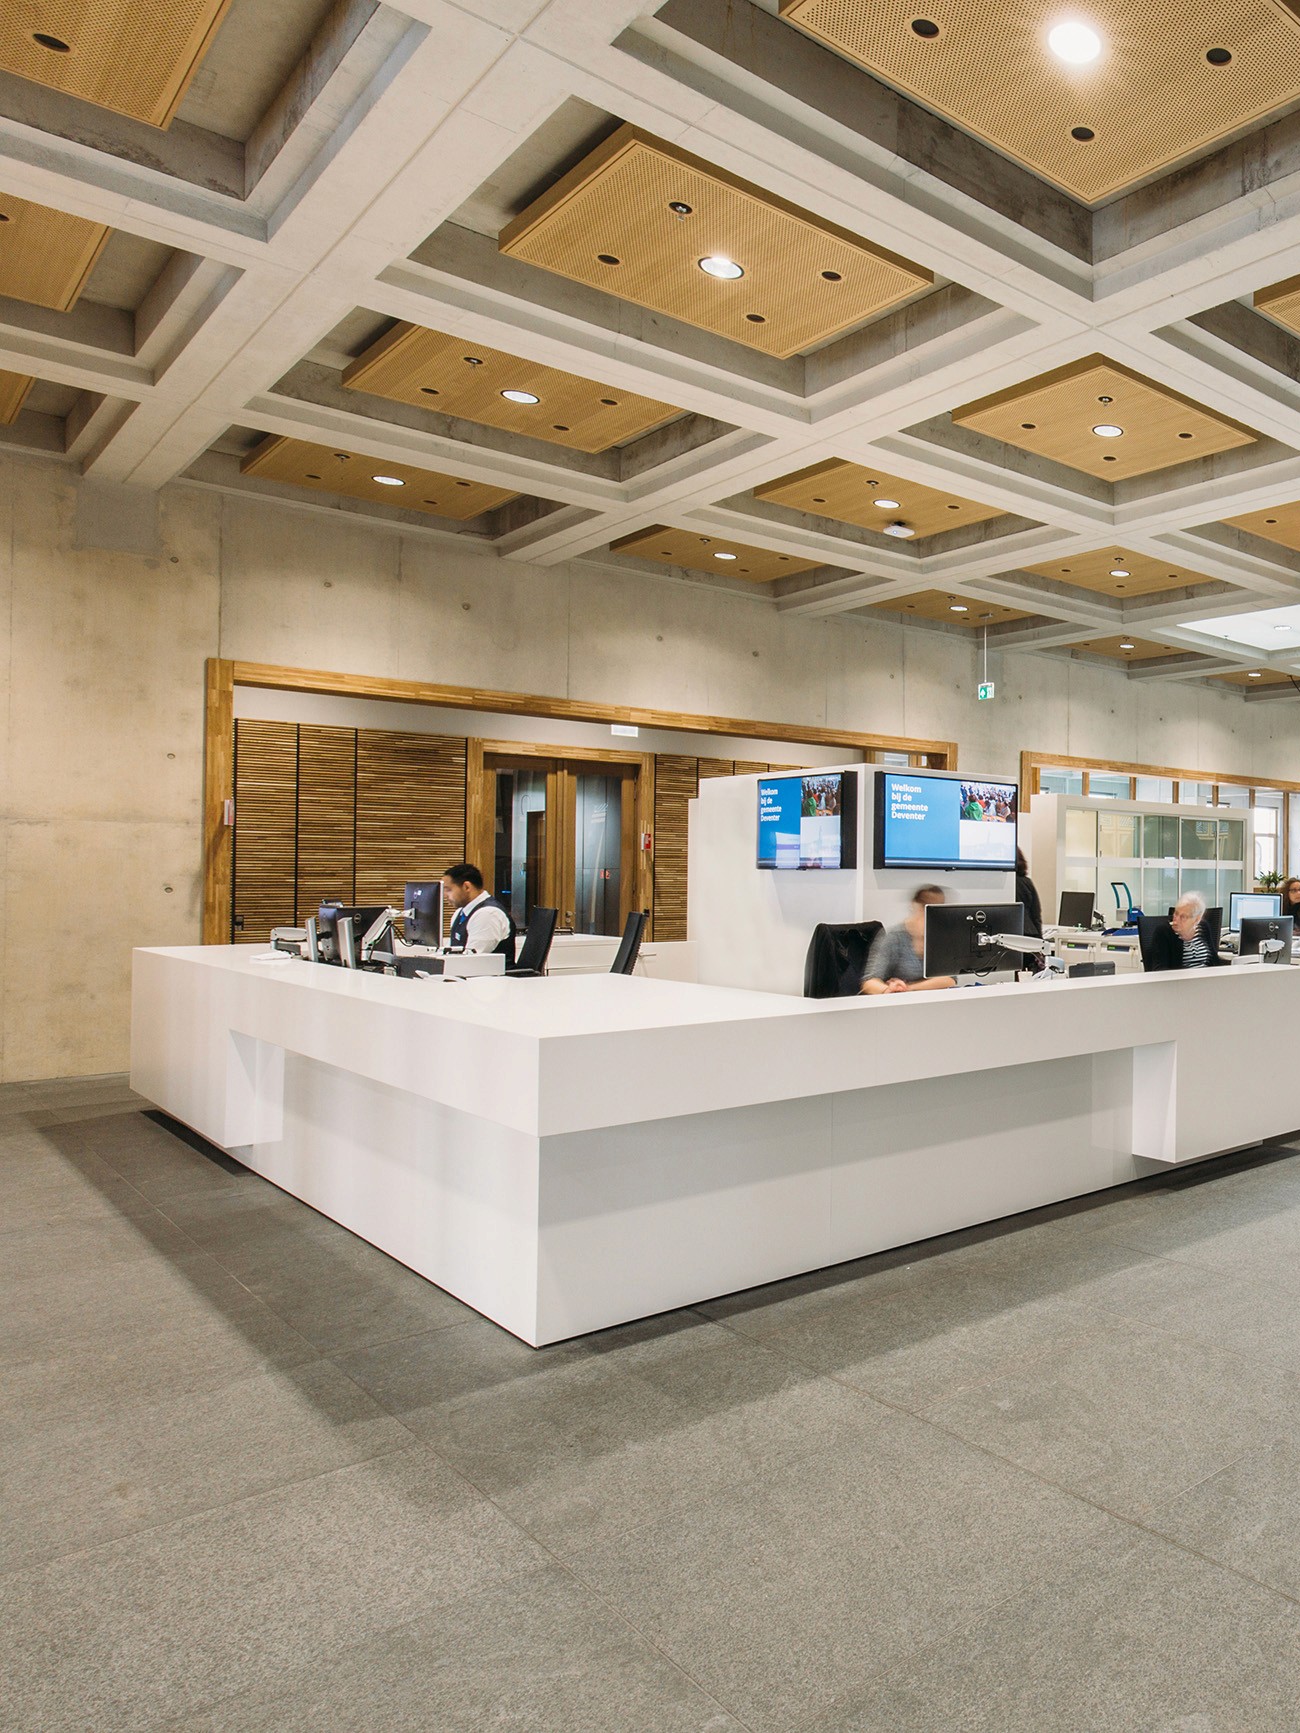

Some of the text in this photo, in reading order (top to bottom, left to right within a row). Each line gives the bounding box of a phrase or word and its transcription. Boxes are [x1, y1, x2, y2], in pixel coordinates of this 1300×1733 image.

[891, 784, 921, 793] Welkom
[891, 792, 912, 802] bij de
[891, 803, 928, 811] gemeente
[891, 811, 925, 820] Deventer
